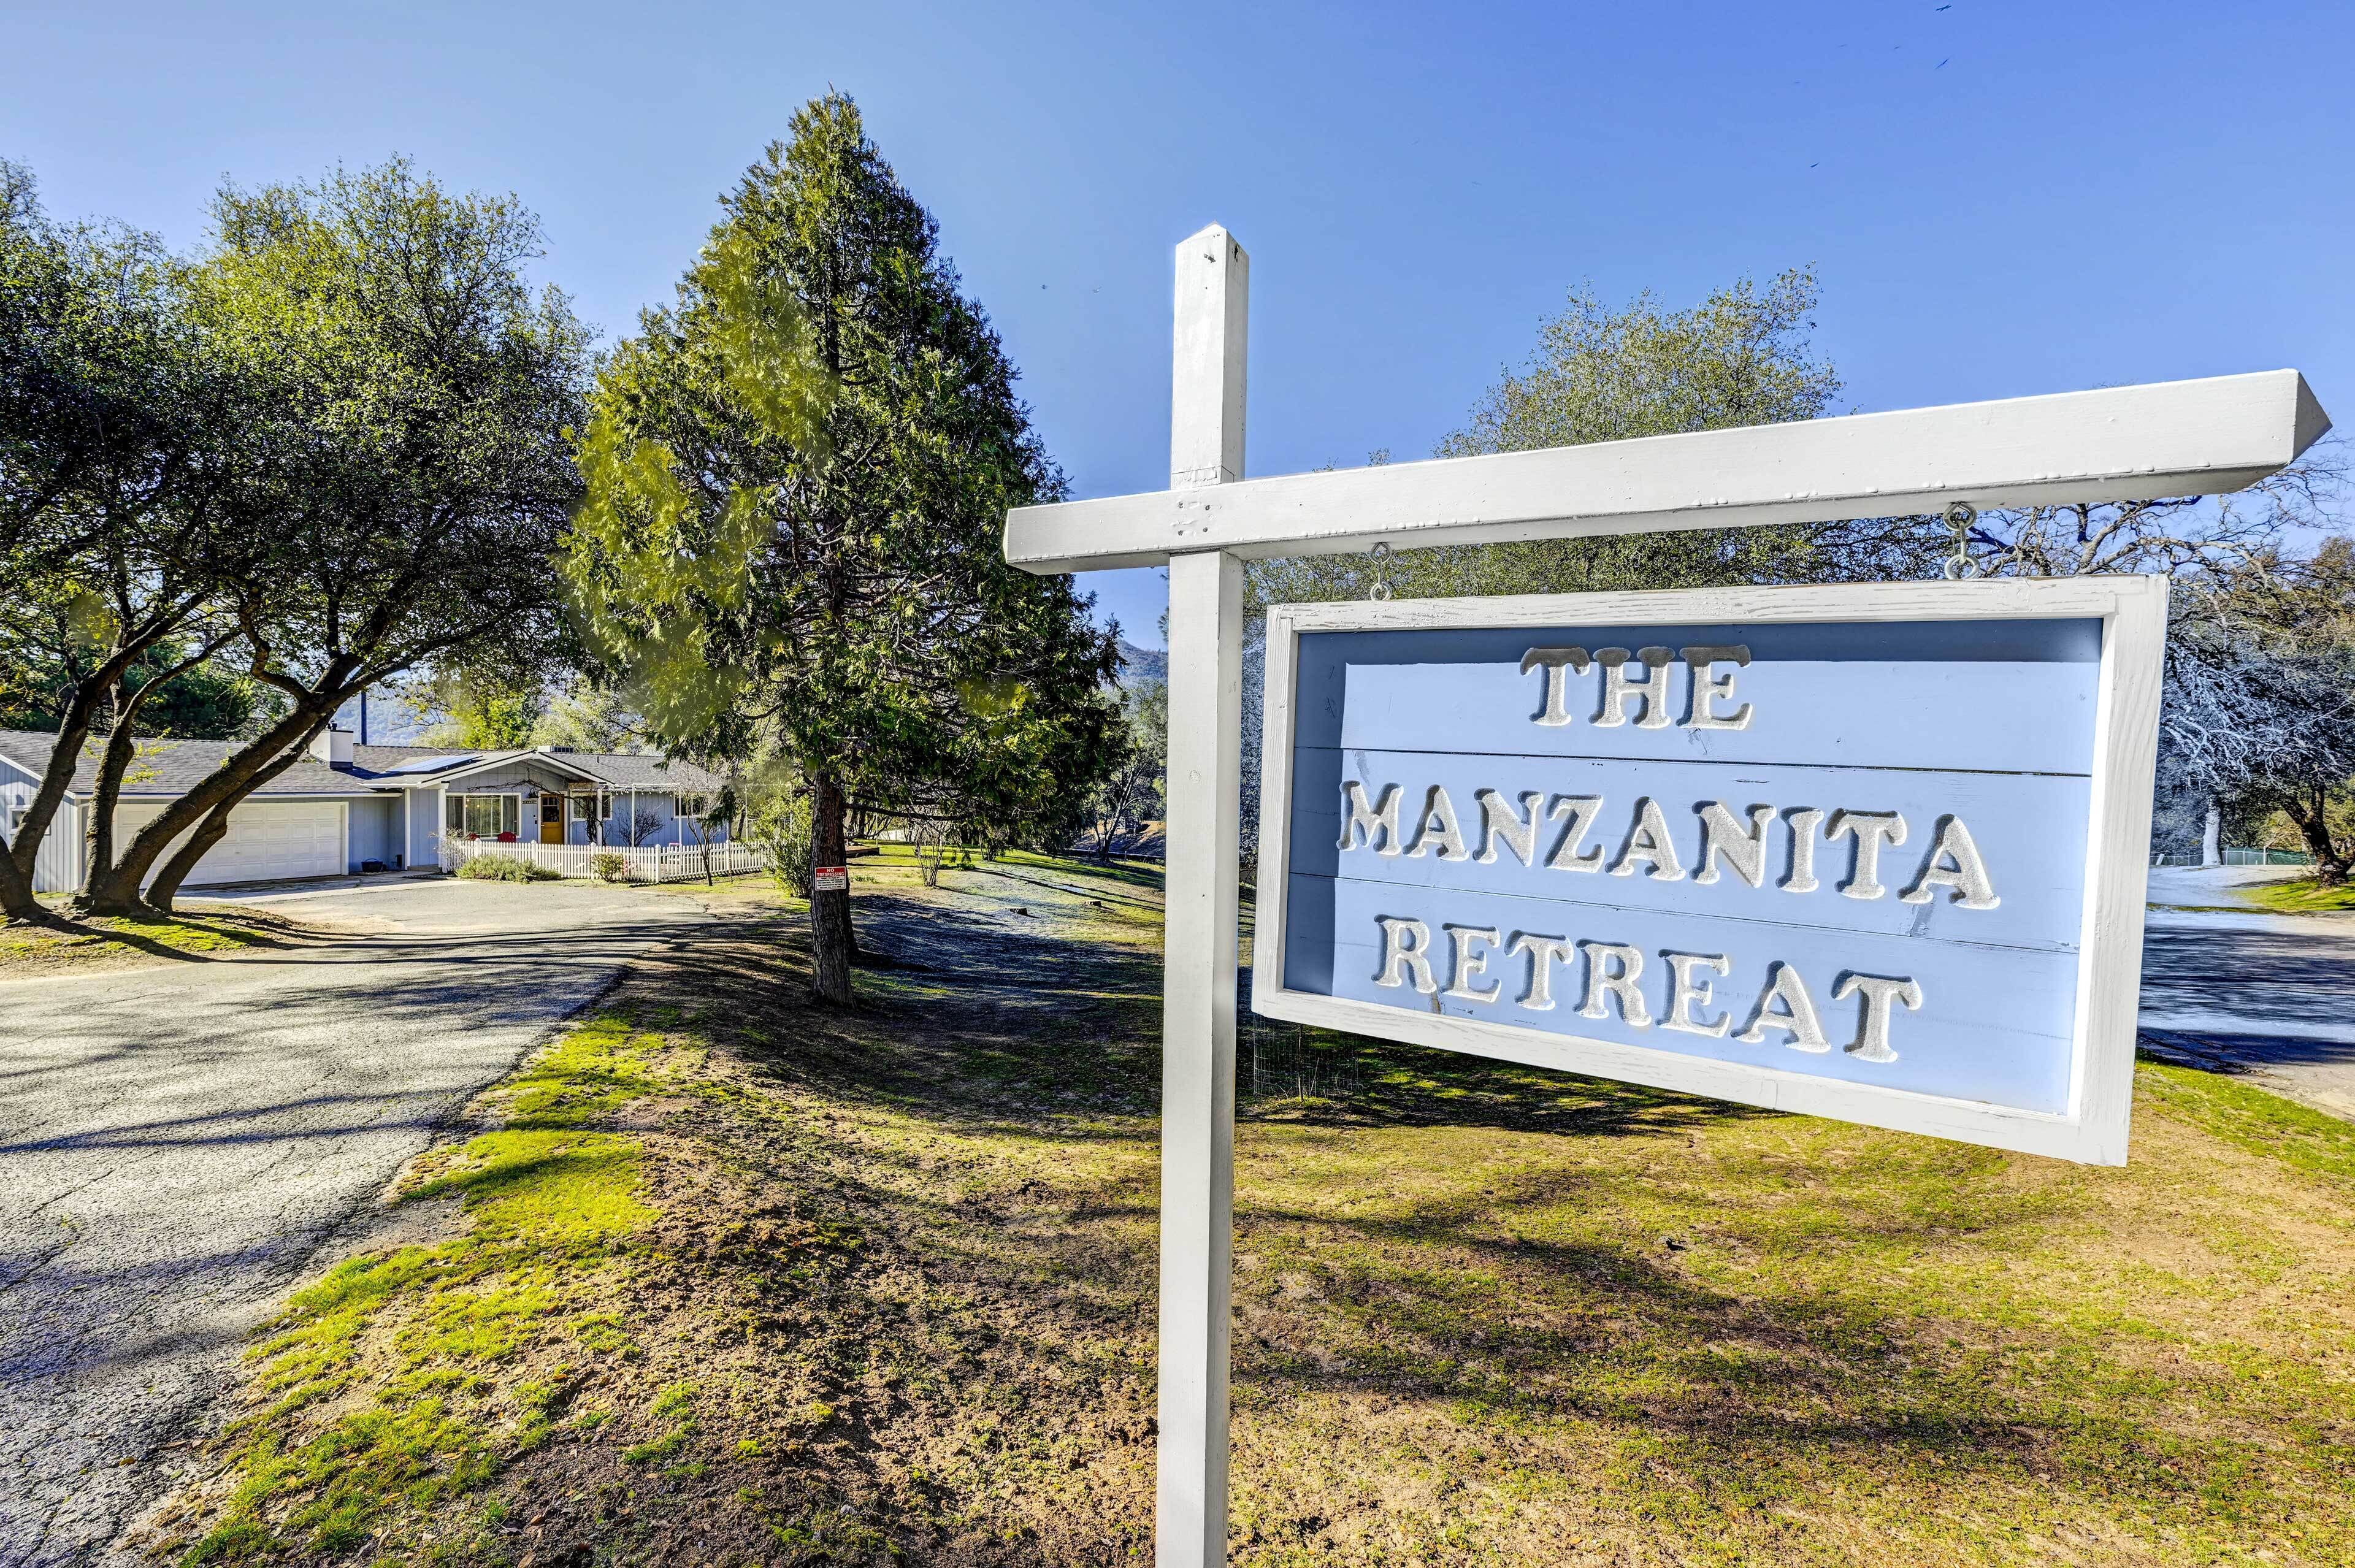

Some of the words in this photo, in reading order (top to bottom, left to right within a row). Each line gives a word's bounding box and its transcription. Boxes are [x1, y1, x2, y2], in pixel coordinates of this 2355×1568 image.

[1519, 644, 1753, 730] THE
[1336, 780, 2001, 910] MANZANITA
[1371, 914, 1923, 1063] RETREAT
